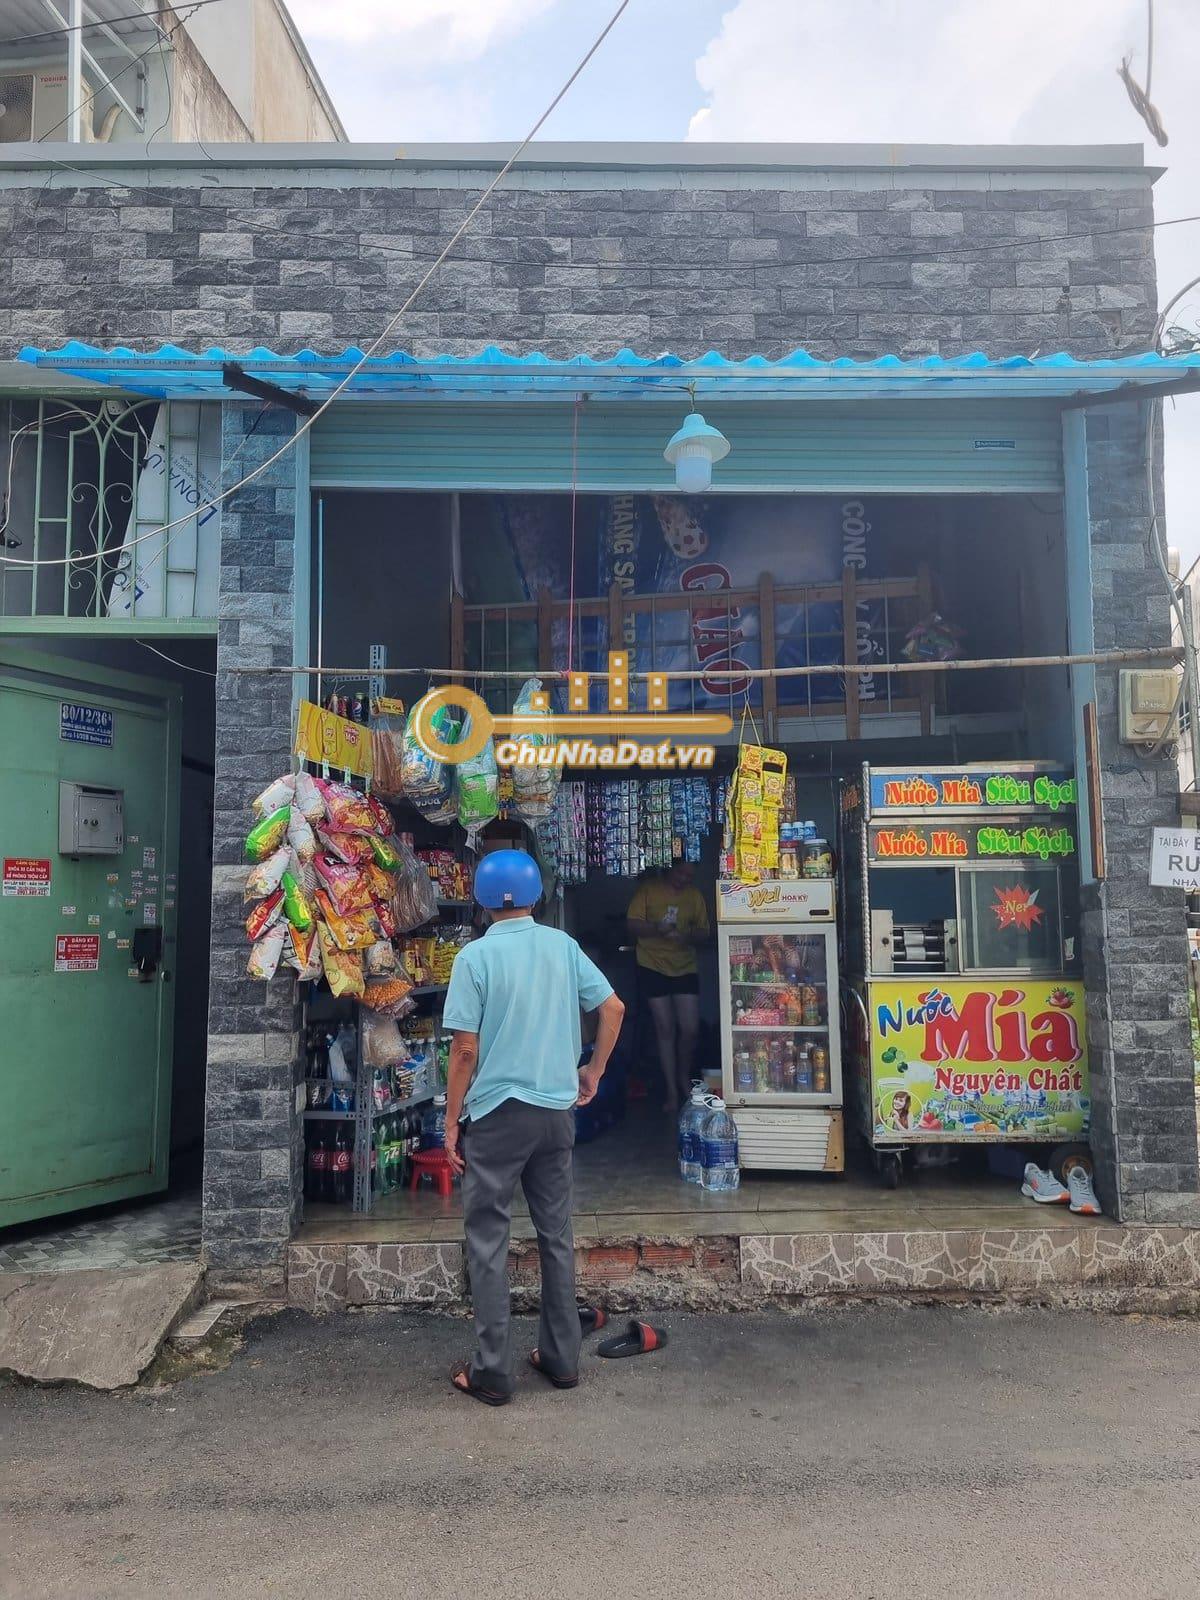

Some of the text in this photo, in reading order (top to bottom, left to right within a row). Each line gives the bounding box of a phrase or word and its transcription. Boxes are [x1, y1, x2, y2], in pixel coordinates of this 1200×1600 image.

[841, 501, 872, 569] CÔNG
[886, 776, 938, 806] Nước
[941, 775, 983, 805] Mía
[877, 830, 927, 856] Nước
[930, 830, 968, 857] Mía
[1022, 826, 1074, 860] Sạch
[1006, 900, 1029, 914] Ne
[877, 988, 953, 1038] Nước
[918, 989, 1082, 1063] Mía
[934, 1064, 1083, 1096] Nguyên Chất
